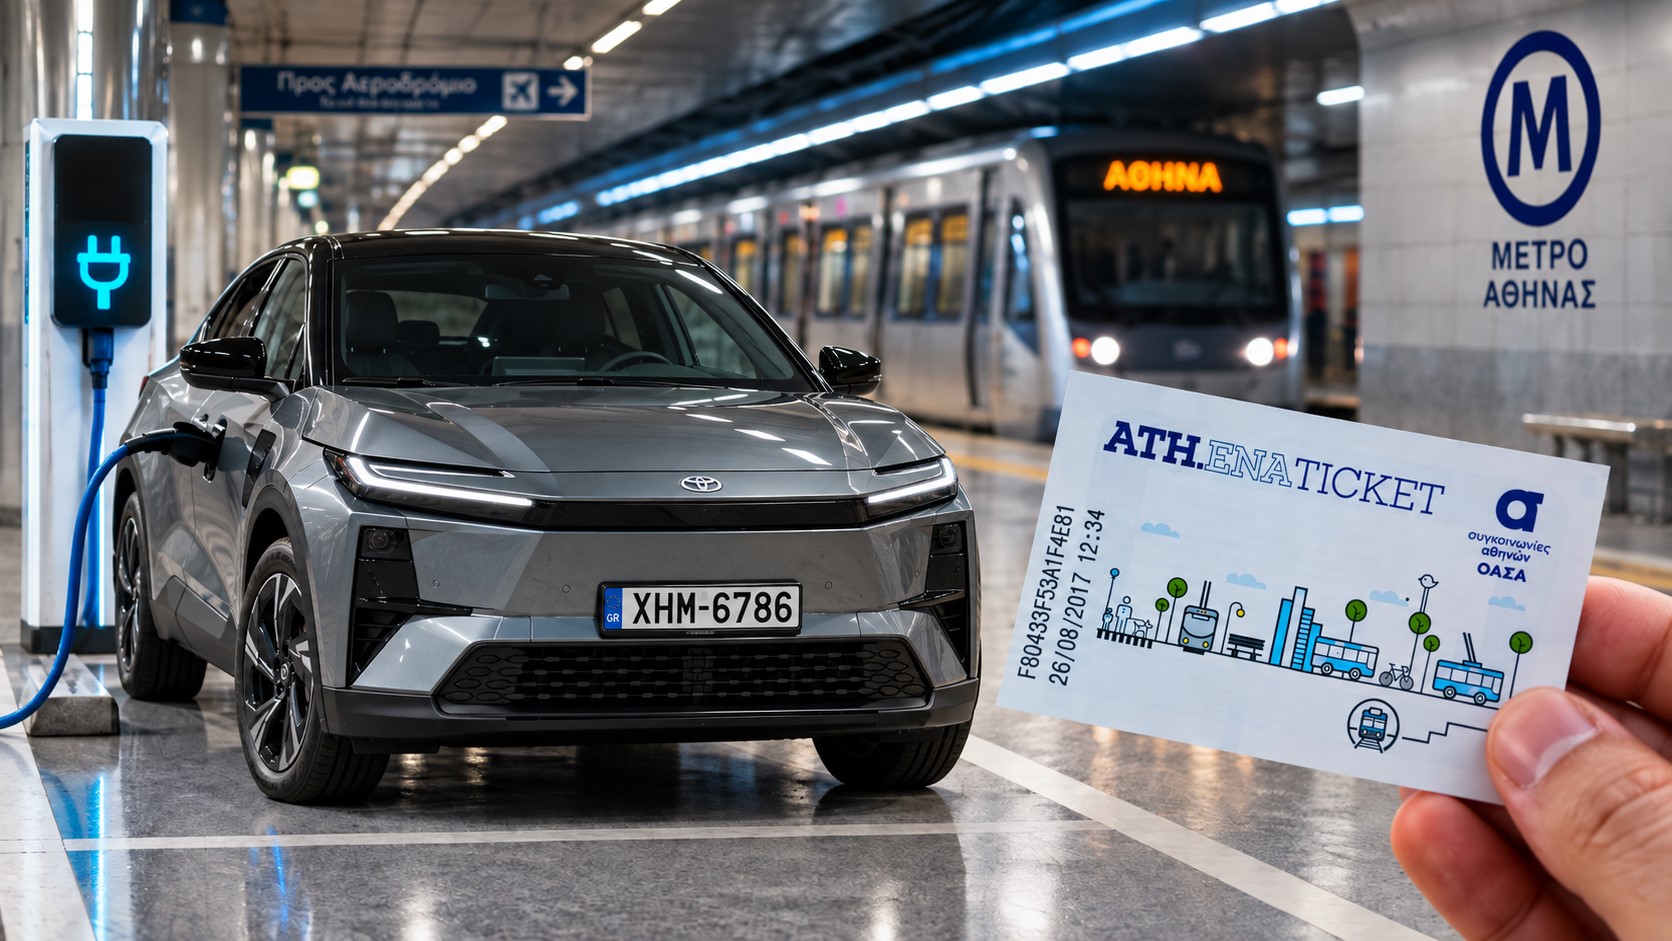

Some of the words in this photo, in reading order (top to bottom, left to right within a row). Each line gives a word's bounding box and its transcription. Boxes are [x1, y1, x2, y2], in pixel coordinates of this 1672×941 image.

[277, 71, 336, 97] Προς
[341, 71, 478, 99] Αεροδρόμιο
[1491, 238, 1588, 270] ΜΕΤΡΟ
[1483, 279, 1597, 309] ΑΘΗΝΑΣ
[1468, 531, 1552, 555] συγκοινωνίες
[1481, 546, 1531, 563] αθηνών
[1477, 562, 1527, 583] ΟΑΣΑ
[1017, 505, 1075, 680] F80433F53A1F4E81
[1049, 572, 1091, 686] 26/08/2017
[1077, 509, 1105, 562] 12:34
[606, 613, 620, 623] GR
[632, 591, 793, 624] XHM-6786
